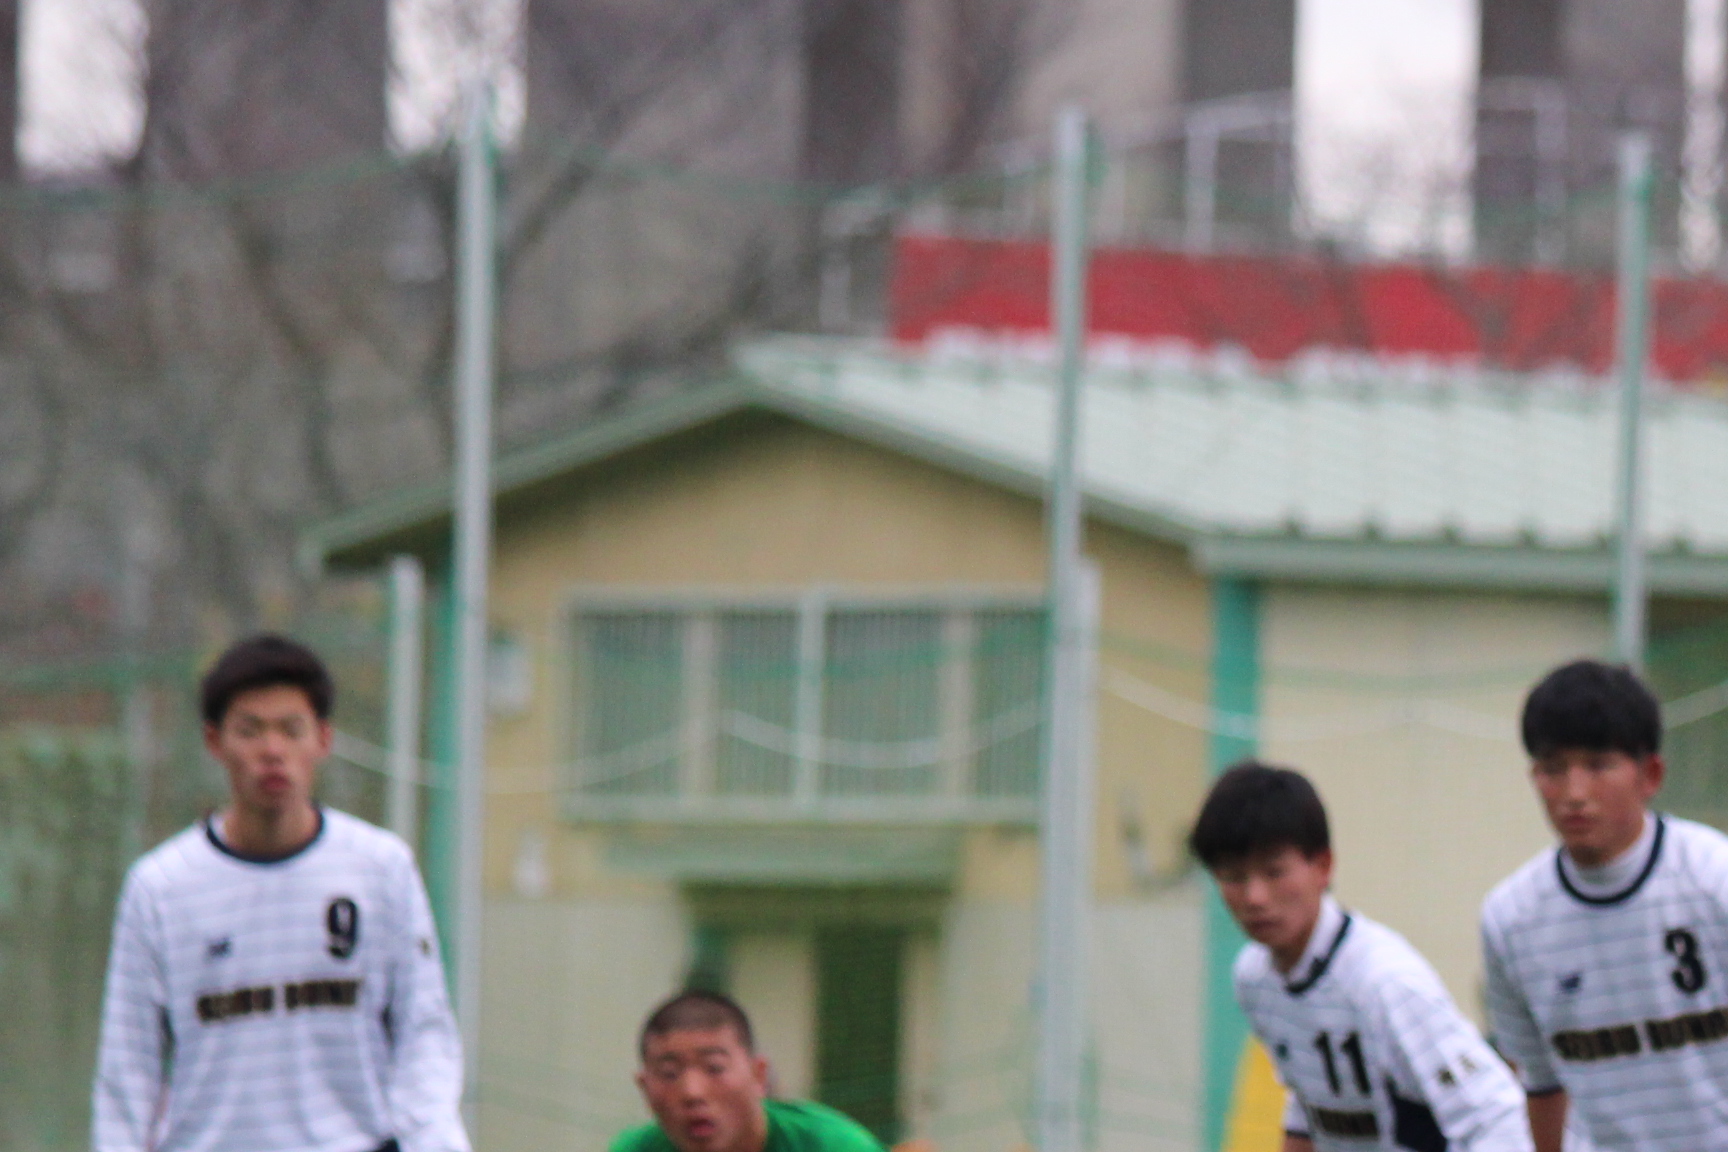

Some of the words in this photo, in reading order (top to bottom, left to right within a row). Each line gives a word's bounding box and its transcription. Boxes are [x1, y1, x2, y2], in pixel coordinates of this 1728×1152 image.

[326, 897, 360, 960] 9
[1663, 929, 1706, 993] 3
[1314, 1031, 1373, 1097] 11
